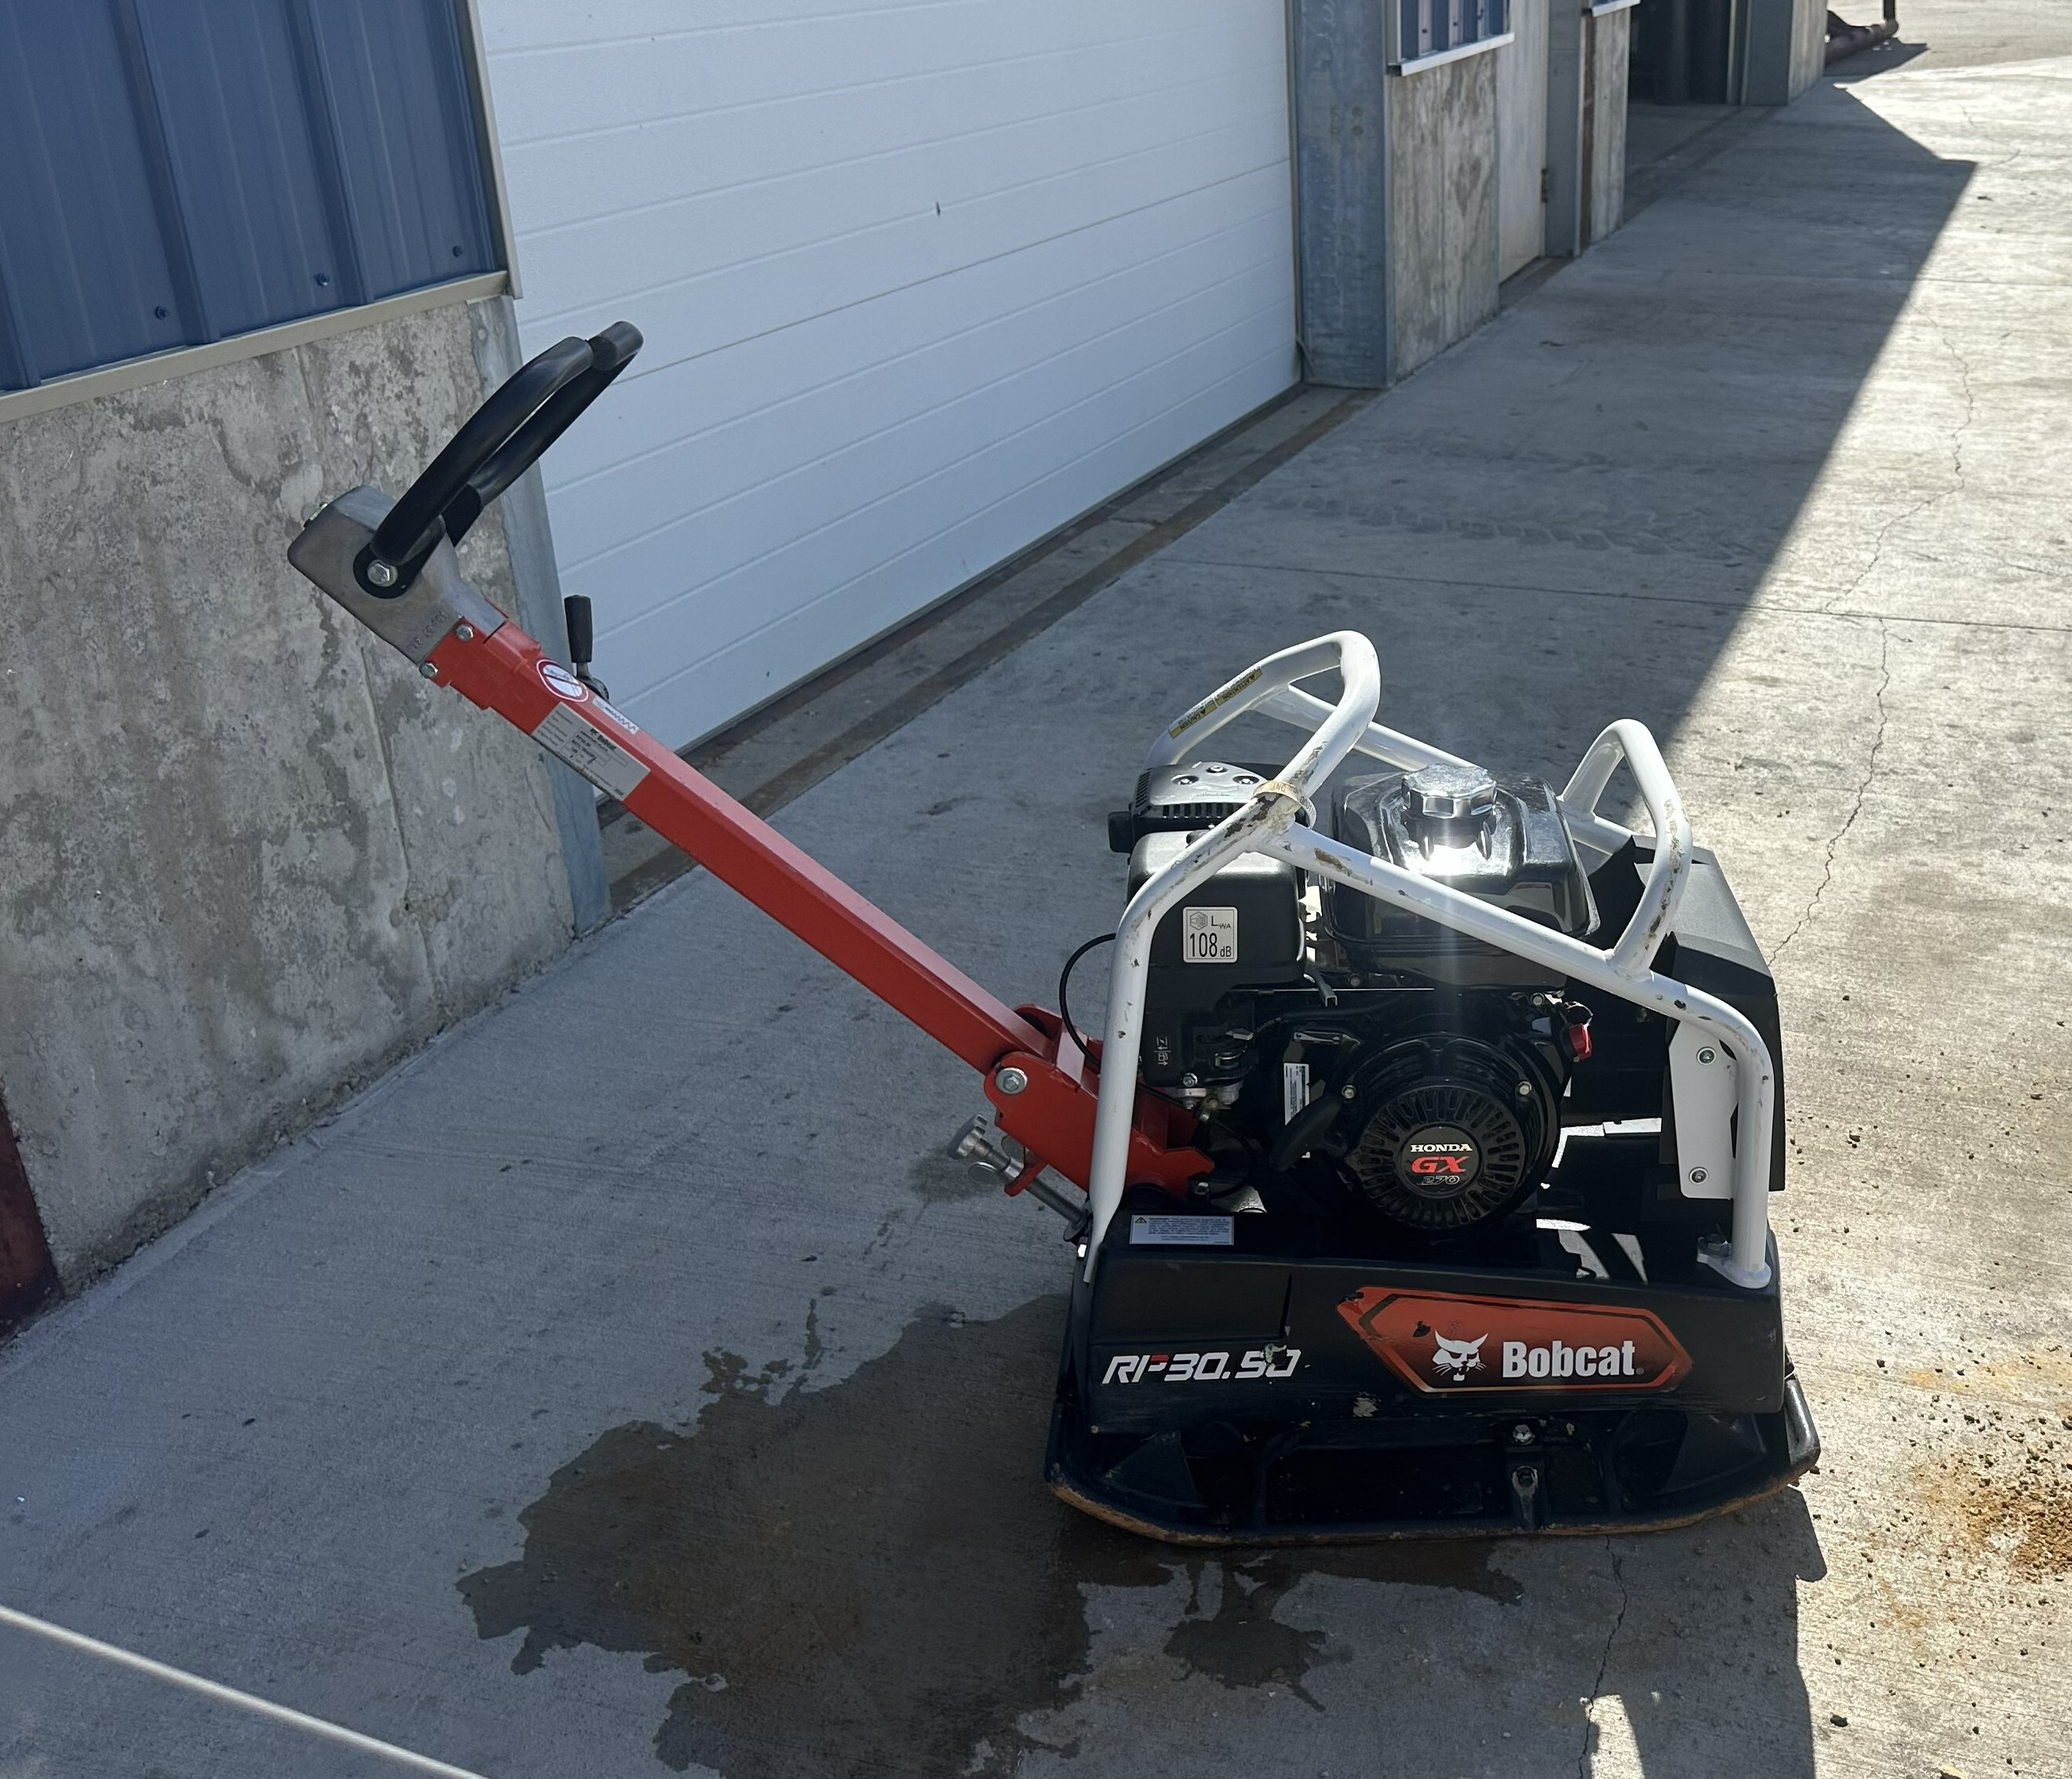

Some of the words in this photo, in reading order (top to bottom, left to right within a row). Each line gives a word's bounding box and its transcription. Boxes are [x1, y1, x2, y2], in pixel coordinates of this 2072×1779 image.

[1189, 932, 1218, 958] 108
[1219, 945, 1232, 958] dB
[1410, 1143, 1473, 1153] HONDA
[1410, 1155, 1469, 1174] GX
[1420, 1175, 1460, 1186] 270
[1502, 1340, 1635, 1378] Bobcat
